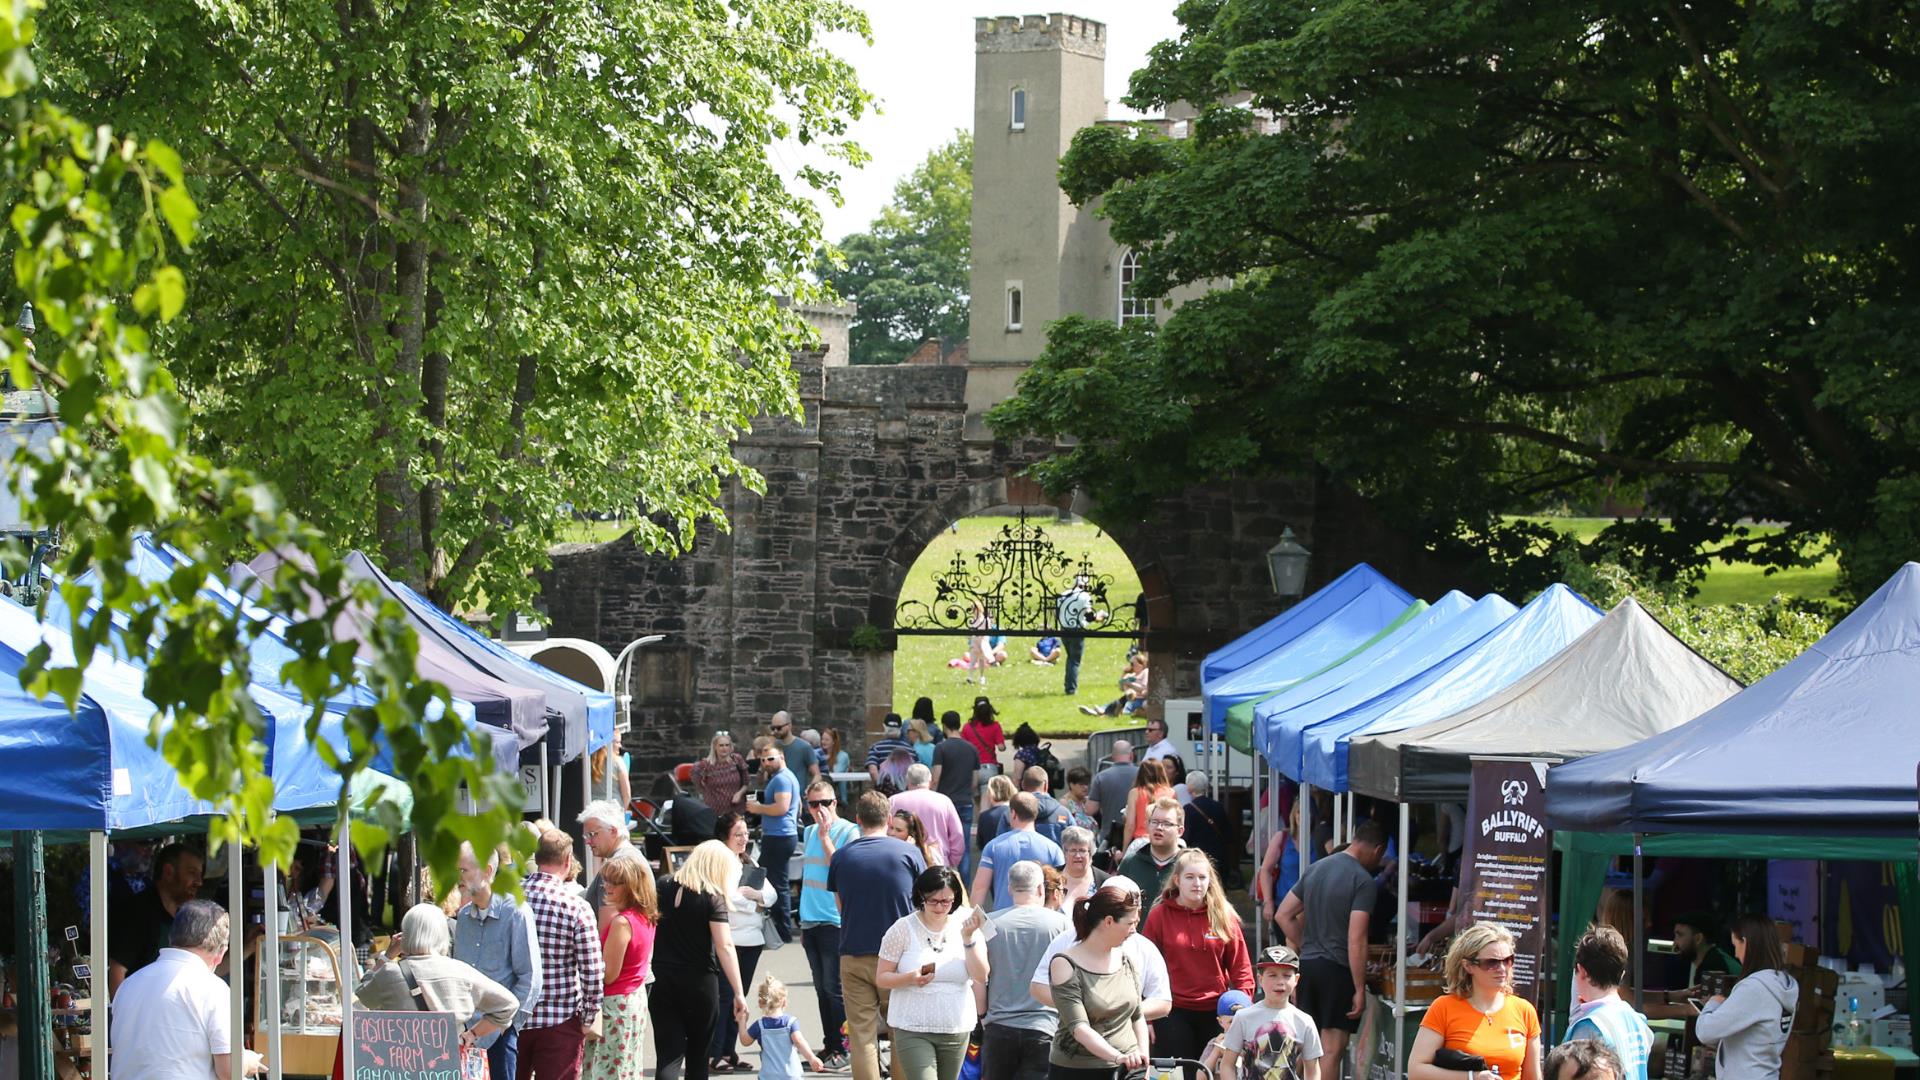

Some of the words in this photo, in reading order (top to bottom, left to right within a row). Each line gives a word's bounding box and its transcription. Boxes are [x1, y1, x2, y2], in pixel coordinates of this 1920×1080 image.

[1481, 810, 1545, 839] BALLYRIFF
[1494, 831, 1527, 843] BUFFALO
[353, 1016, 449, 1050] CASTLESCREED
[389, 1046, 426, 1072] FARM
